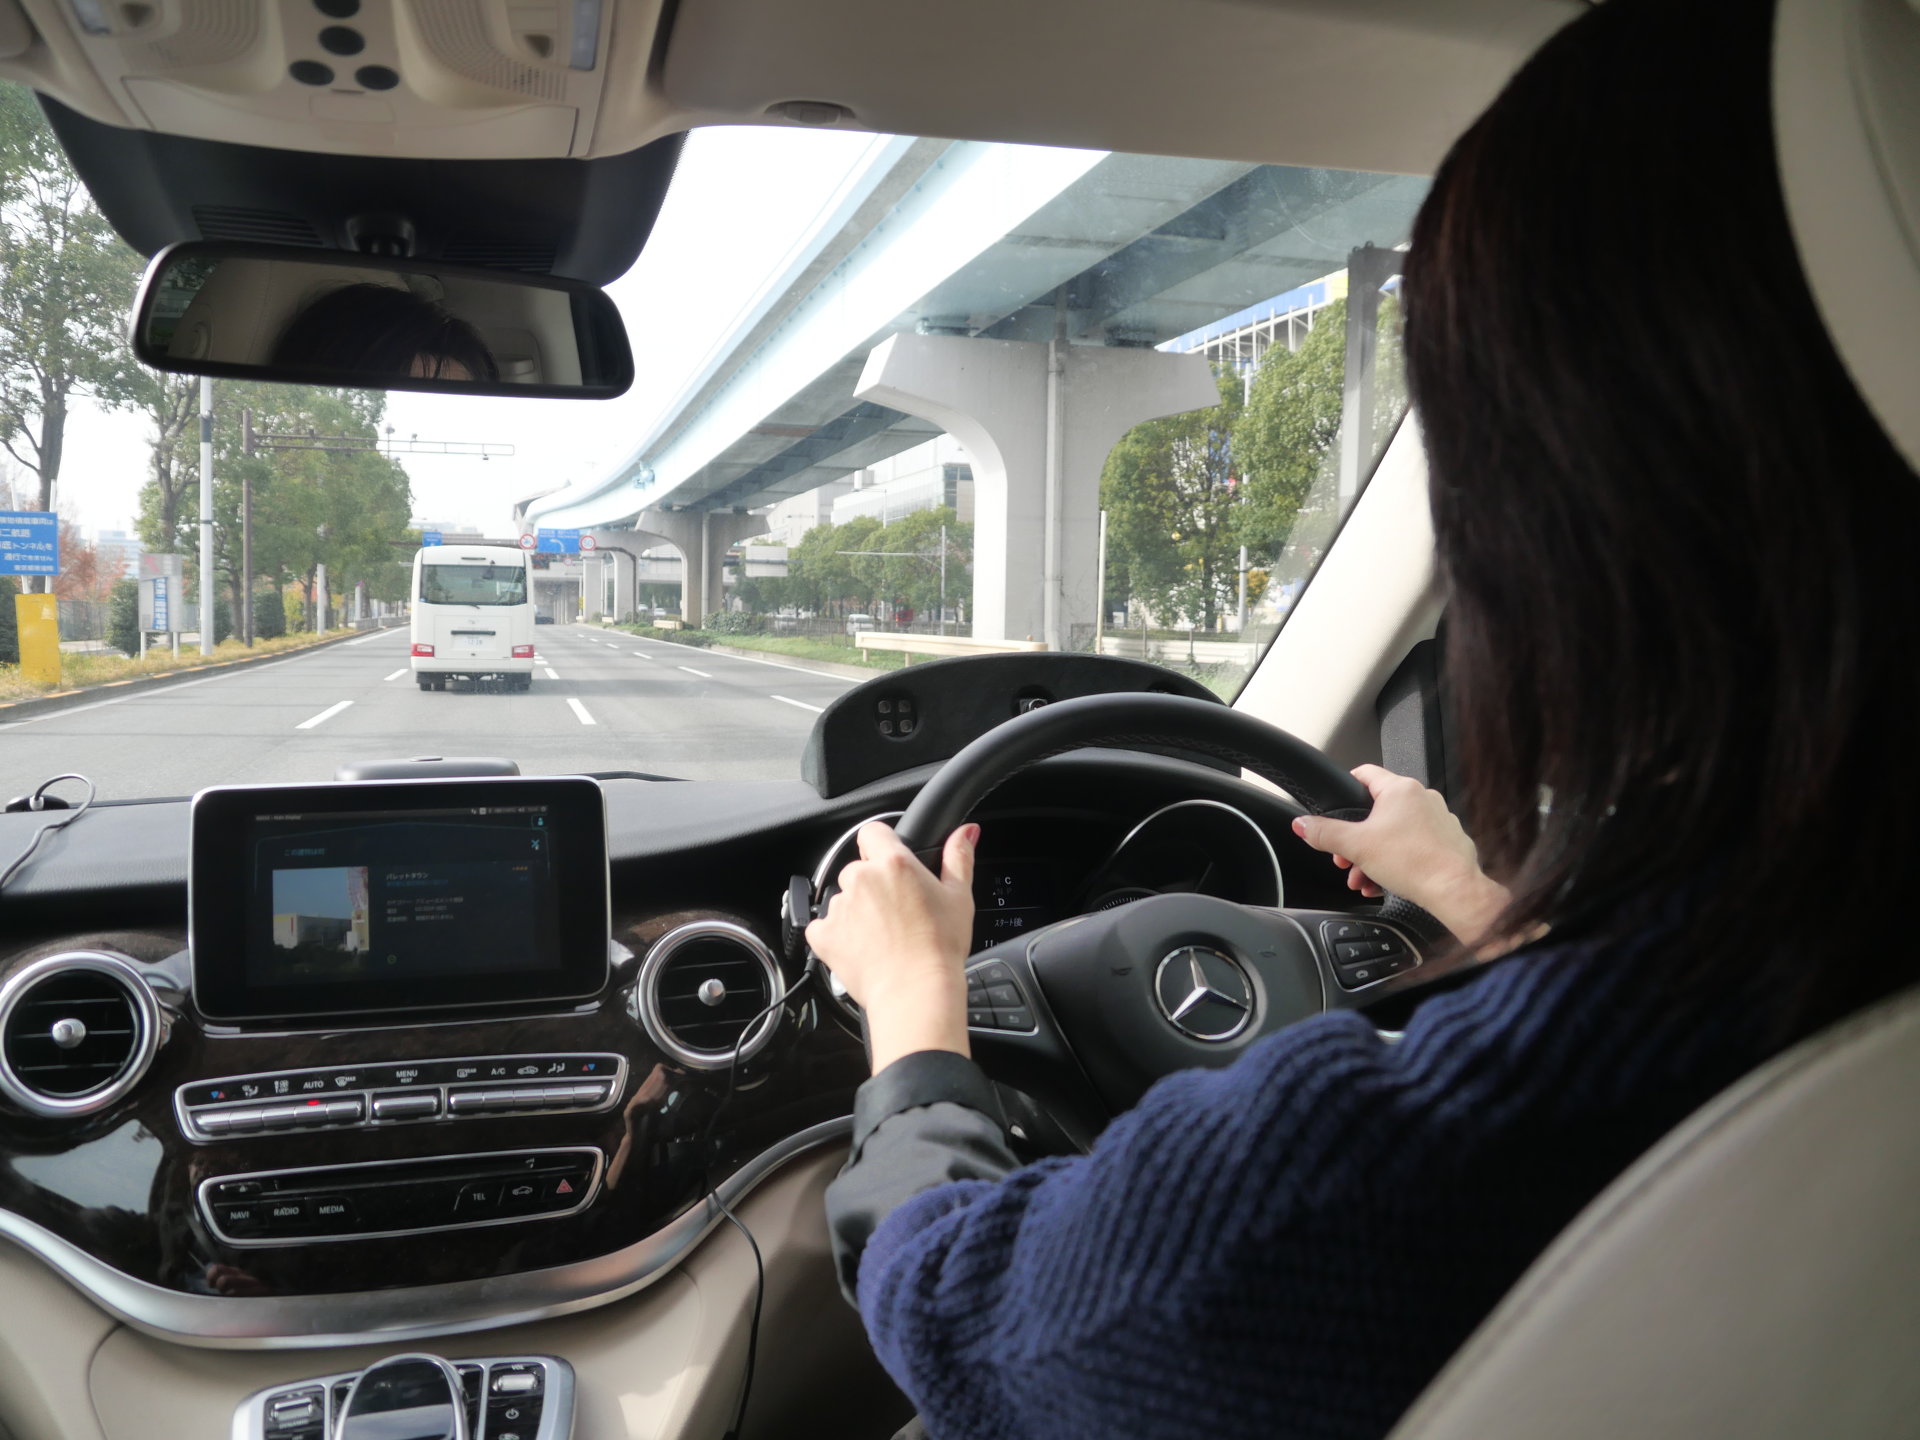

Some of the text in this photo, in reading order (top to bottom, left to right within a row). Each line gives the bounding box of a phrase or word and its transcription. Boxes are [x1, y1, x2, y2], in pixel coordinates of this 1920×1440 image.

[0, 528, 31, 537] 二航路
[0, 541, 53, 551] 底トンネルを
[998, 897, 1005, 906] D
[396, 1069, 418, 1078] MENU
[491, 1067, 506, 1076] A/C
[303, 1080, 324, 1090] AUTO
[472, 1192, 486, 1201] TEL
[273, 1207, 300, 1217] RADIO
[319, 1204, 345, 1215] MEDIA
[230, 1211, 250, 1220] NAVI
